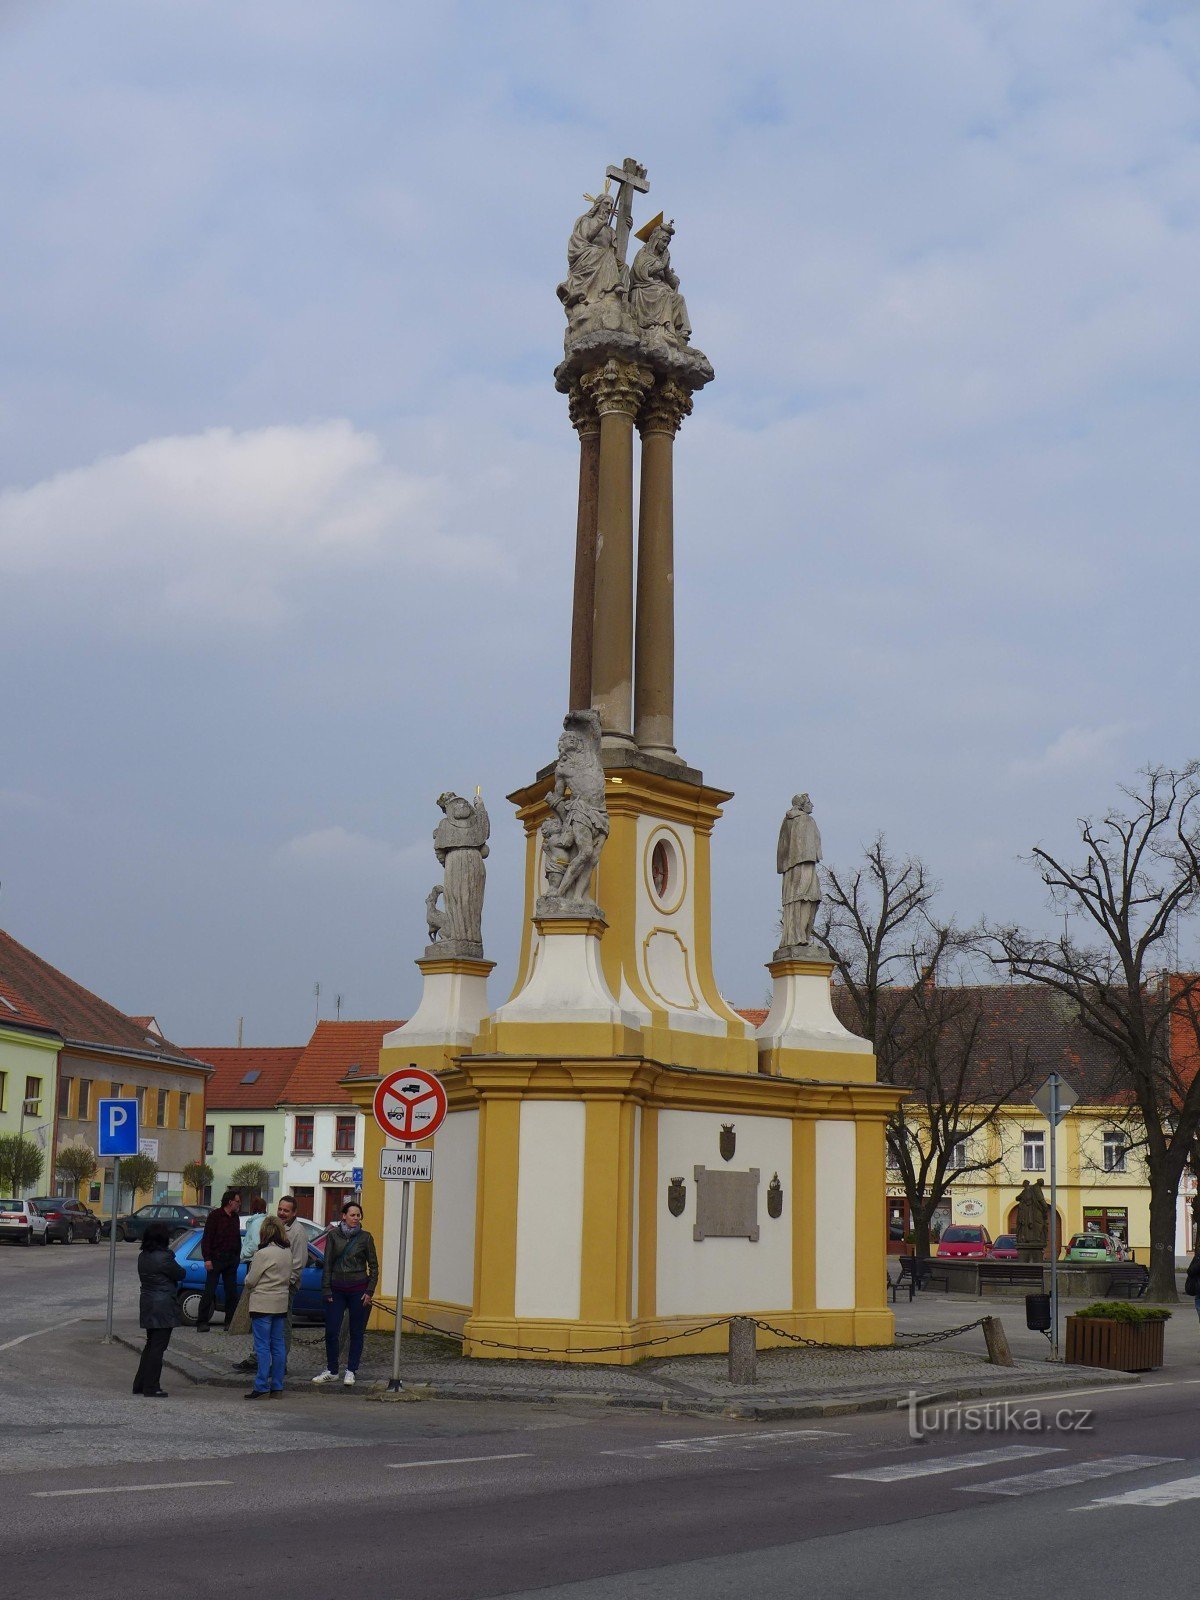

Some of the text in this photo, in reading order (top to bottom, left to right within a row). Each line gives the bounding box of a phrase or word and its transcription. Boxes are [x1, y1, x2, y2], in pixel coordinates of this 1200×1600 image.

[109, 1106, 128, 1137] P
[396, 1154, 417, 1163] MIMO
[382, 1165, 428, 1177] ZÁSOBOVÁNÍ
